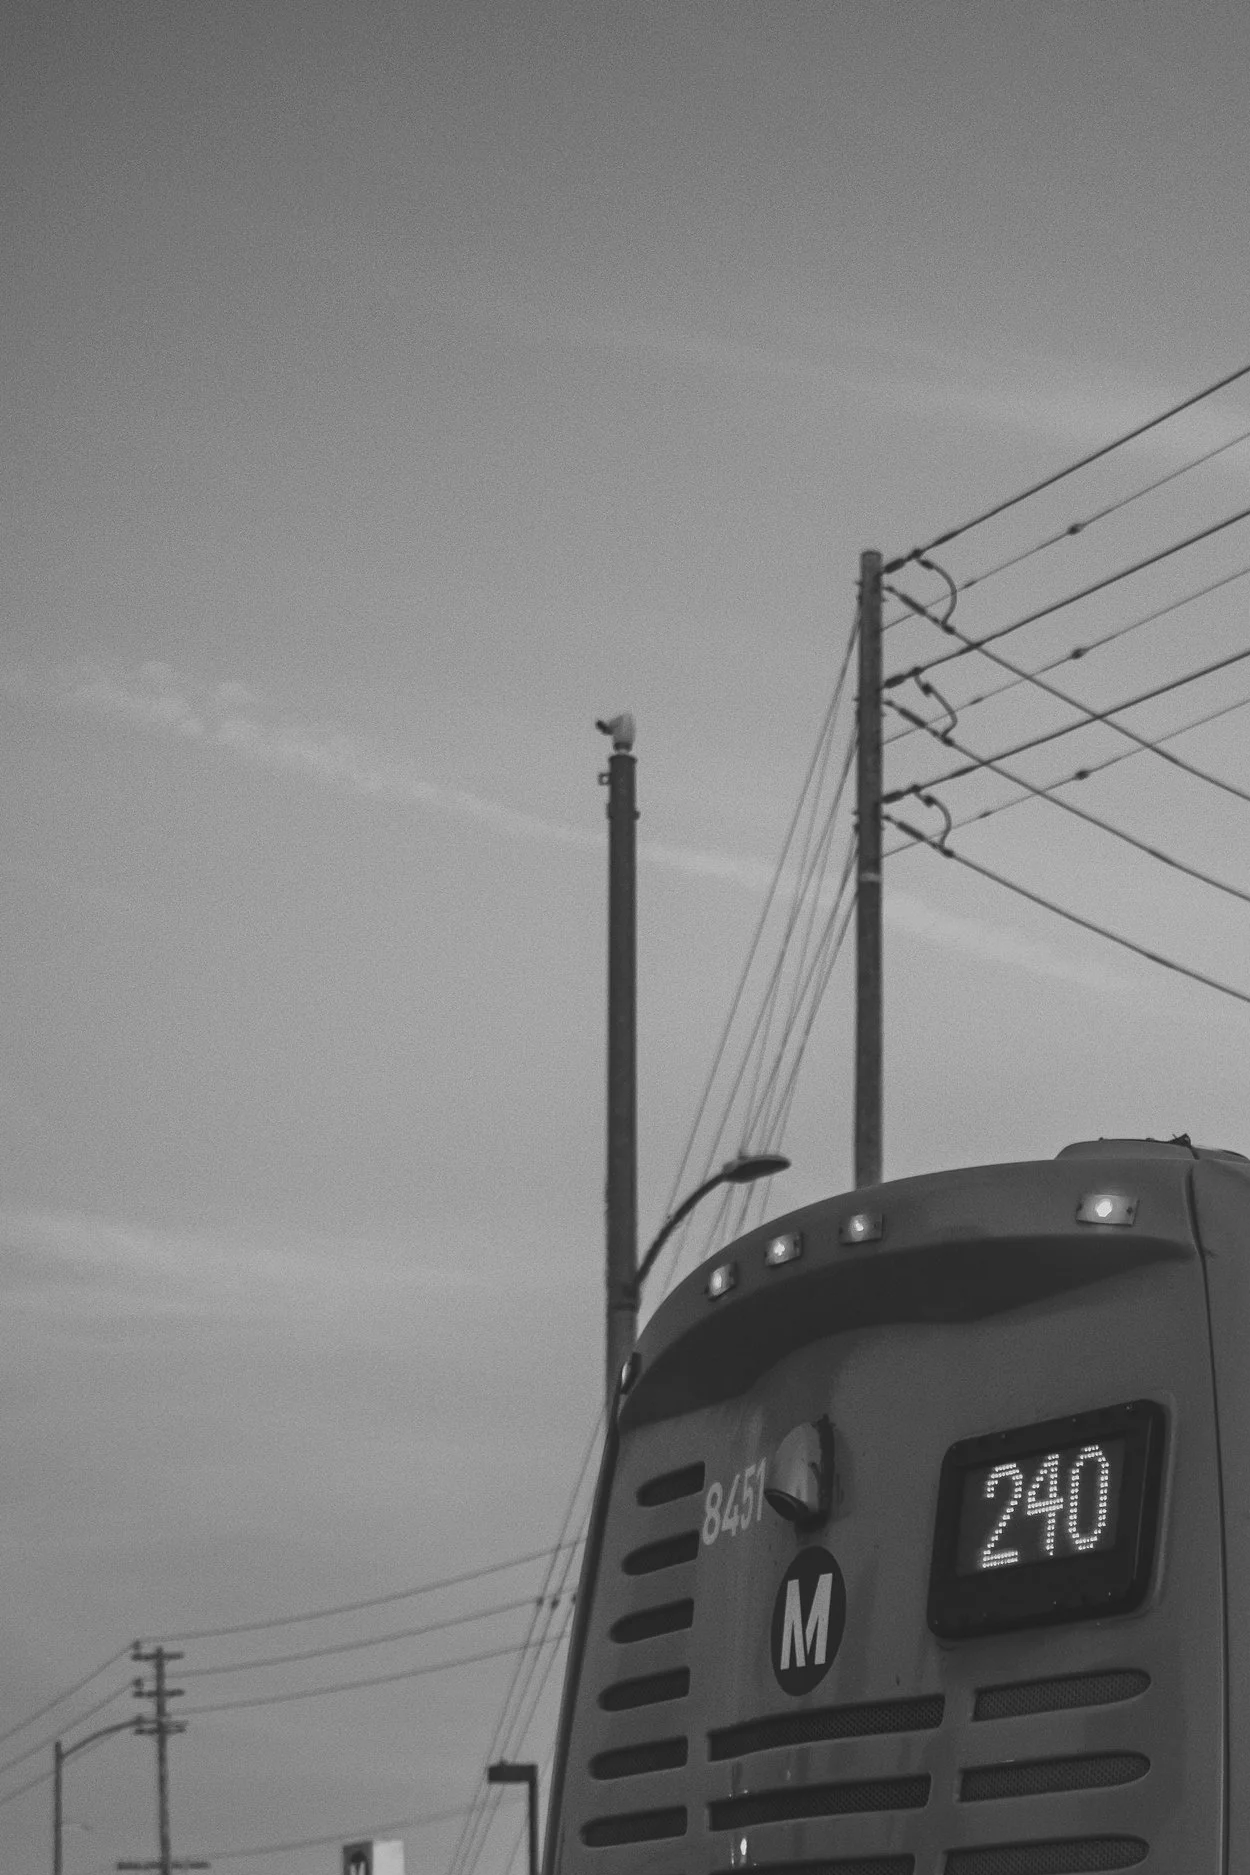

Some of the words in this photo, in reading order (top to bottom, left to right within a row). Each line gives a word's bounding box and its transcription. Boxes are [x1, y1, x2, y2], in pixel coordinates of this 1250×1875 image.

[702, 1456, 767, 1546] 8451
[982, 1444, 1110, 1569] 240
[780, 1572, 833, 1671] M
